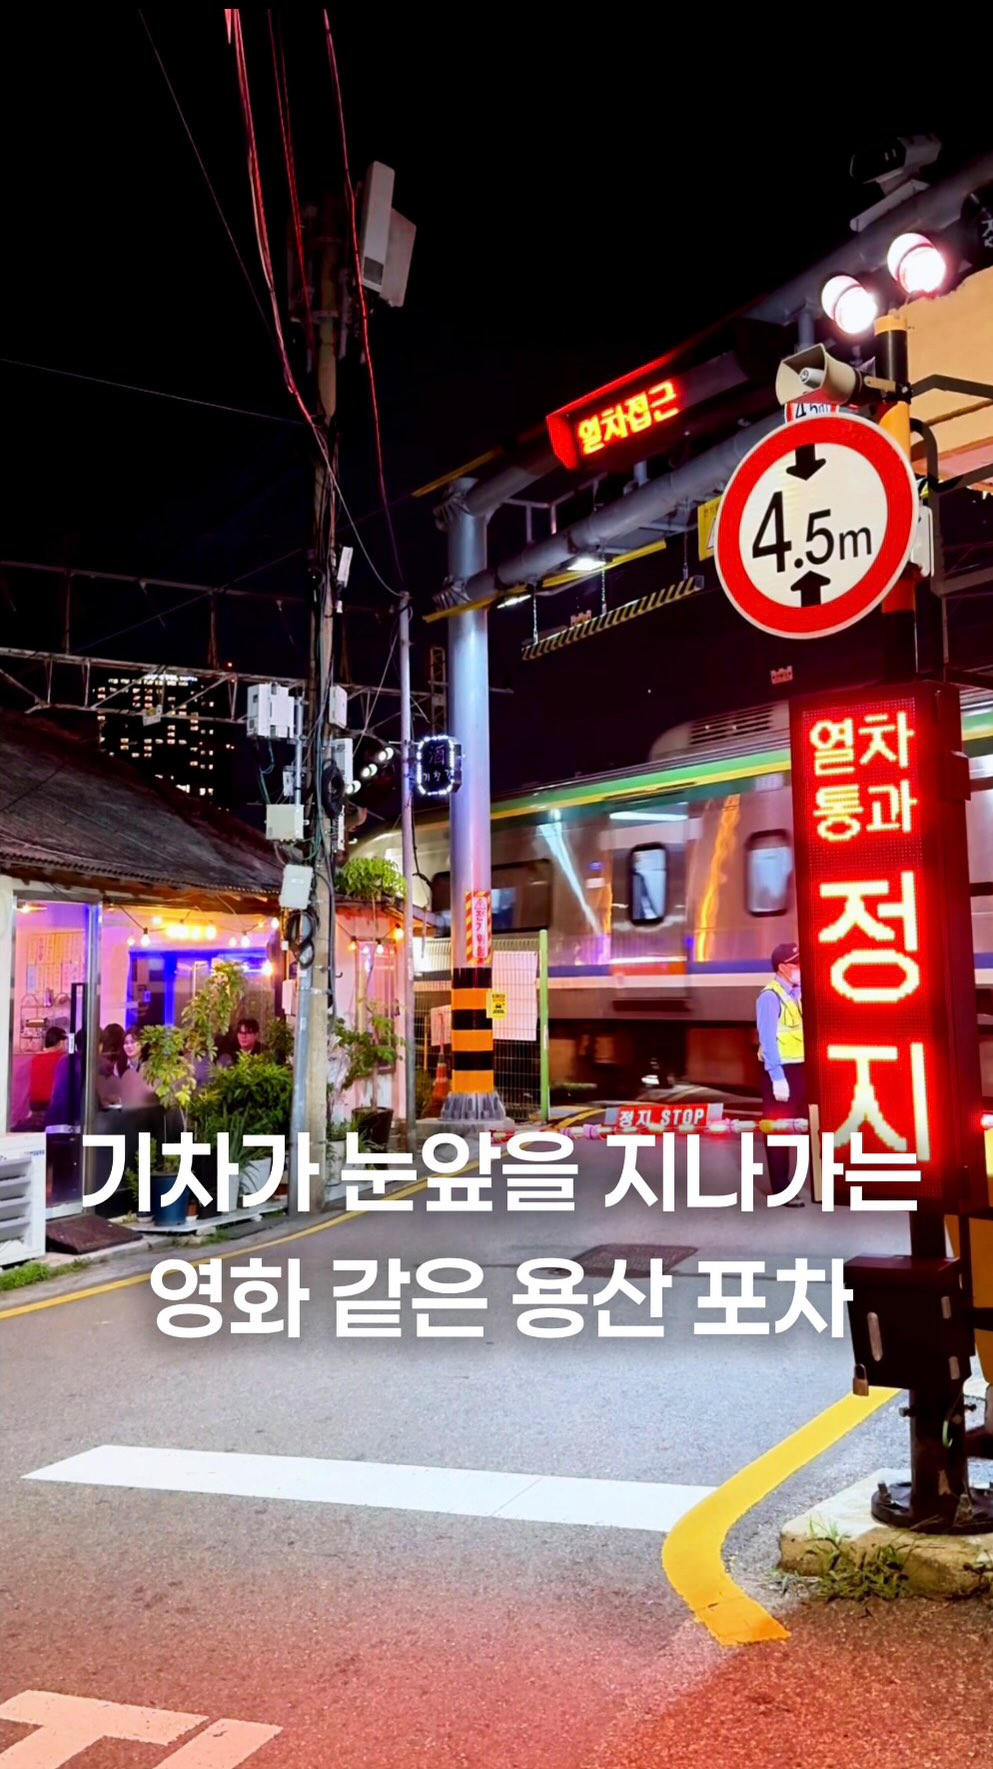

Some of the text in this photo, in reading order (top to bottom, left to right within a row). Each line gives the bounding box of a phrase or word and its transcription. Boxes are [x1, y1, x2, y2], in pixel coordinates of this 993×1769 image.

[578, 380, 679, 455] 열차접근
[752, 491, 872, 573] 4.5m
[809, 711, 915, 776] 열차
[813, 779, 918, 842] 통과
[818, 871, 931, 1163] 정지
[618, 1108, 705, 1128] 정지 STOP
